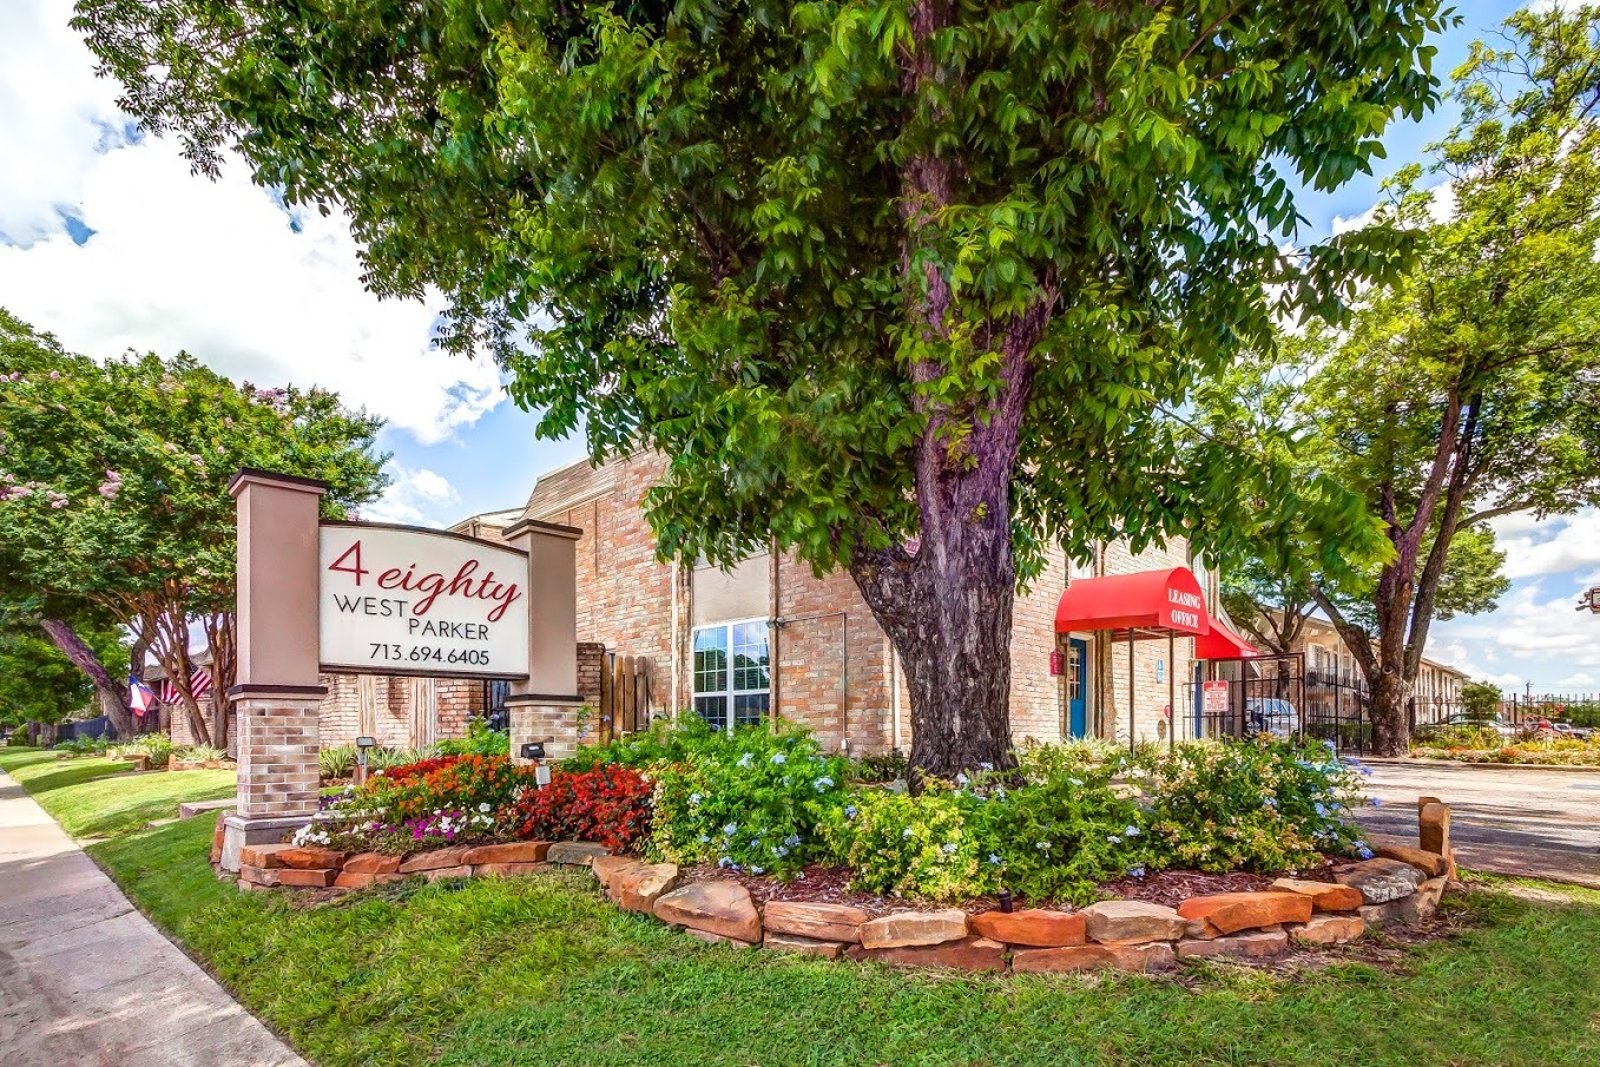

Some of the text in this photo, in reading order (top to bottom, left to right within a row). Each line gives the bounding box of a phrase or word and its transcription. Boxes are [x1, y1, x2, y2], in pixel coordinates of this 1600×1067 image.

[333, 593, 409, 617] WEST
[1168, 588, 1201, 610] LEASING
[408, 618, 489, 640] PARKER
[1171, 609, 1199, 628] OFFICE
[369, 643, 490, 665] 713.694.6405
